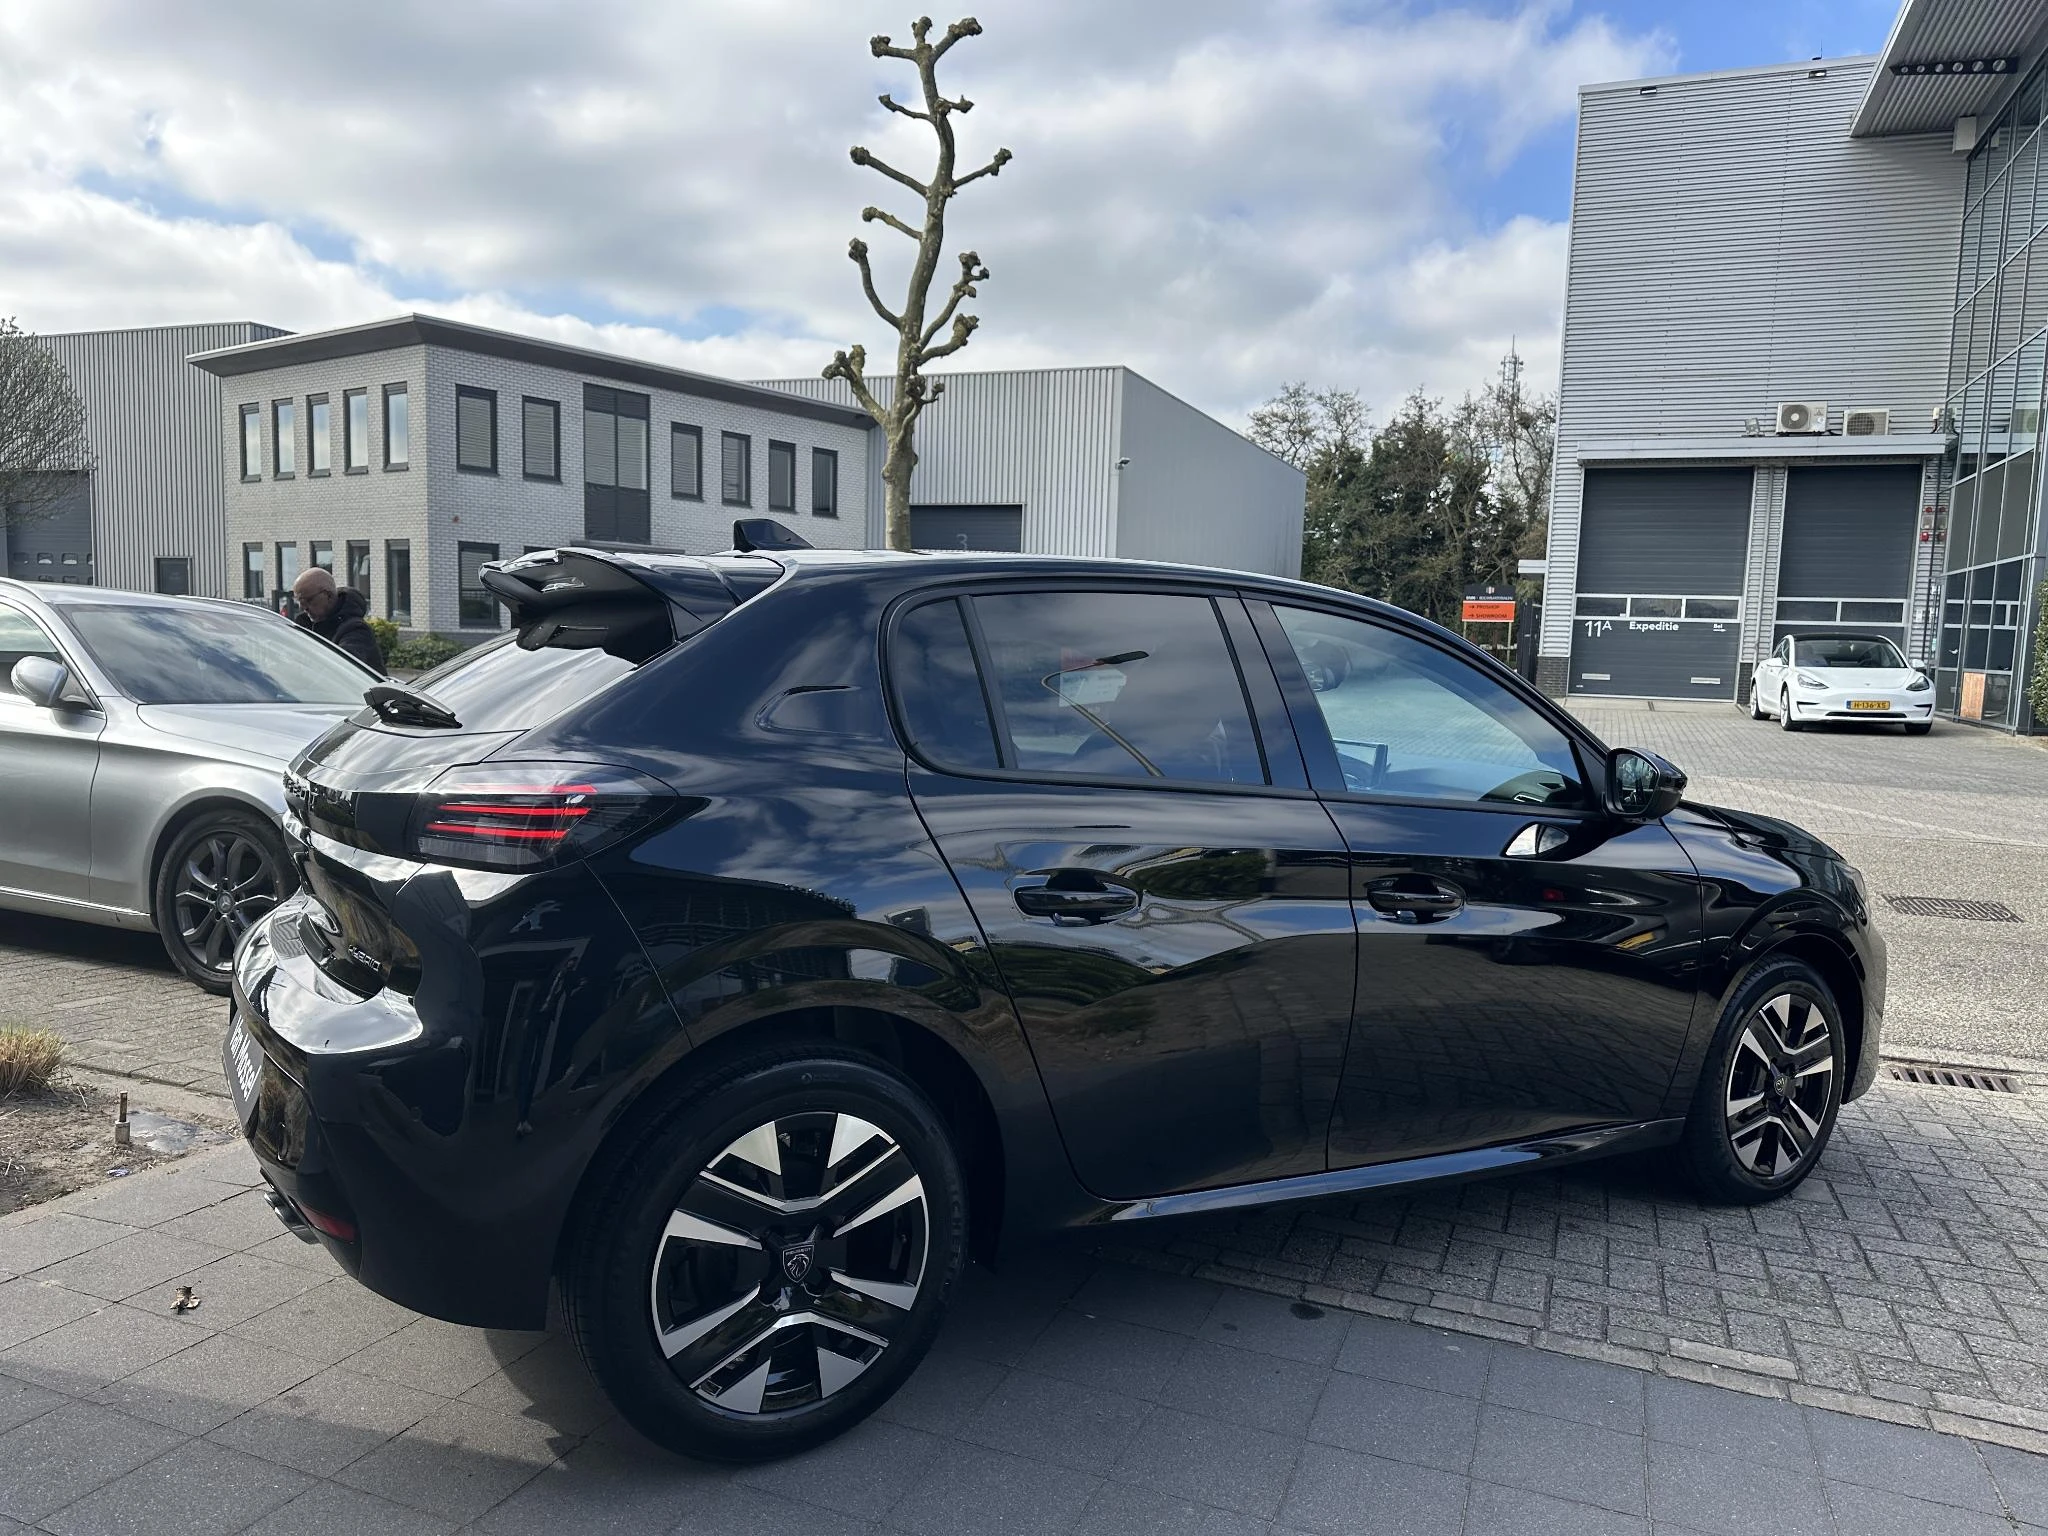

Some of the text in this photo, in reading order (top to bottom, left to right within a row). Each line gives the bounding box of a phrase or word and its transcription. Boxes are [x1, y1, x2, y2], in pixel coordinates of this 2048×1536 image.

[1628, 621, 1680, 633] Expeditie
[229, 1013, 261, 1102] Van Mossel
